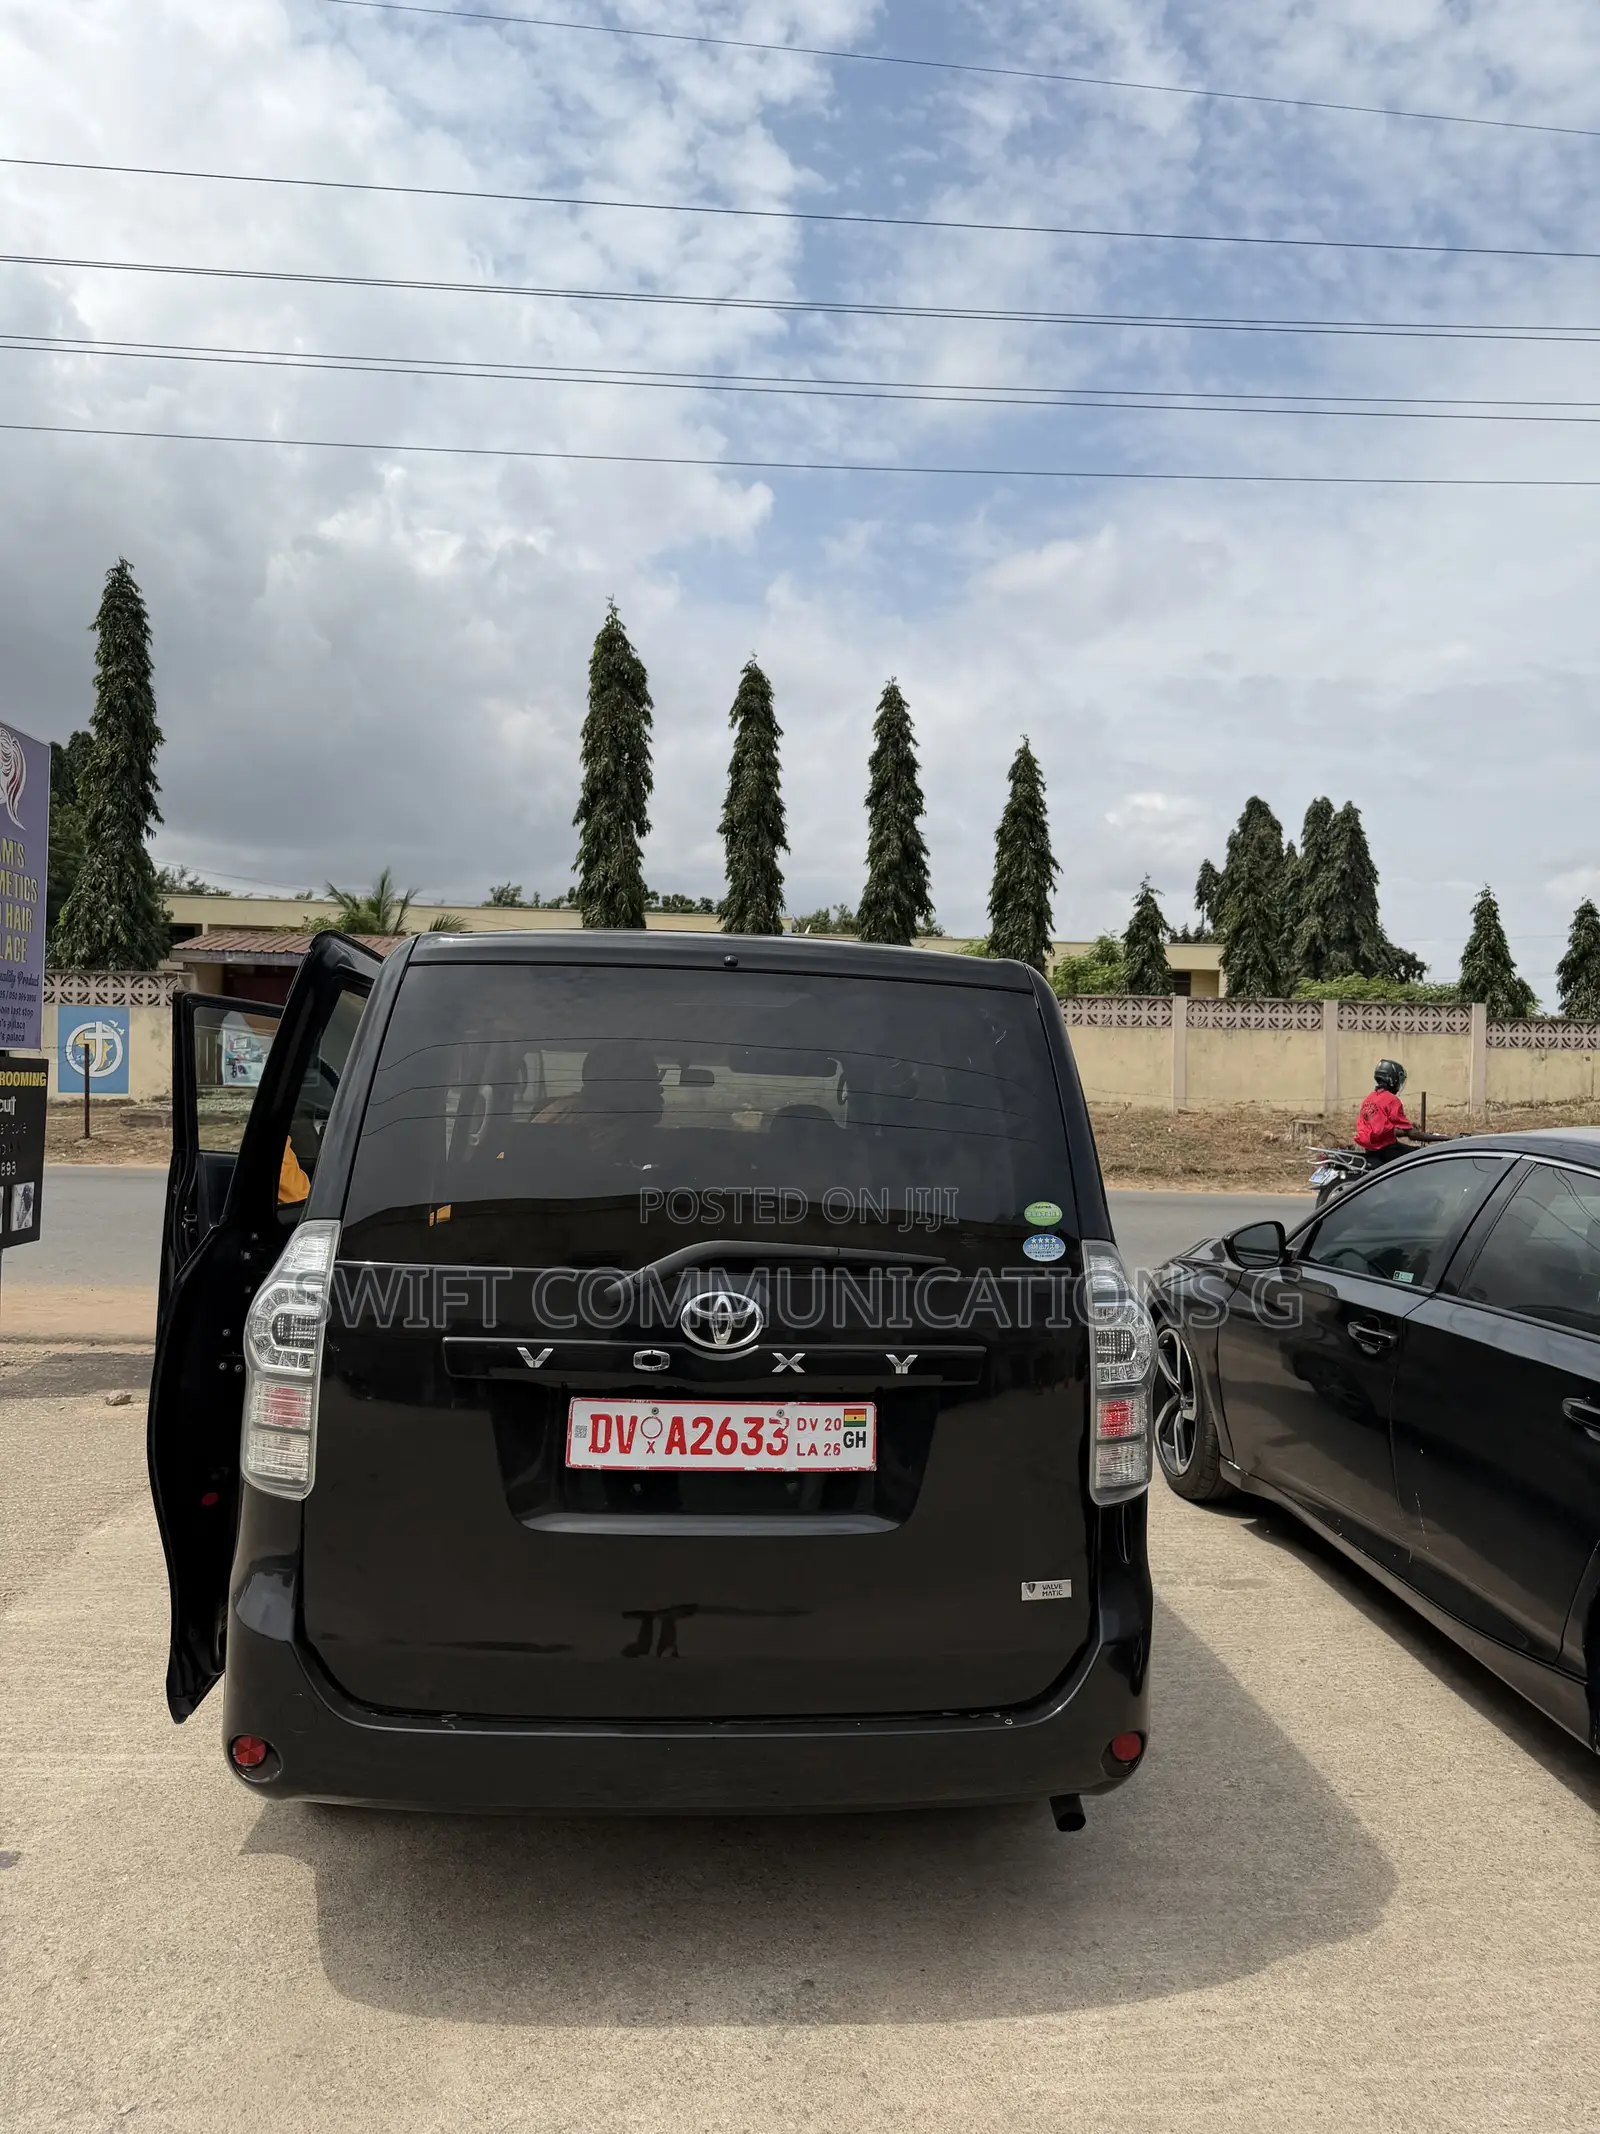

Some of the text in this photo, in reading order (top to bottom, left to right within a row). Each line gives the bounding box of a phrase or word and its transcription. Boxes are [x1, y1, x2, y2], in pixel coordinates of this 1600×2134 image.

[0, 837, 26, 869] M'S
[5, 902, 33, 934] HAIR
[0, 1071, 47, 1087] ROOMING
[516, 1346, 919, 1375] VOXY
[796, 1417, 842, 1432] DV 20
[588, 1413, 790, 1456] DV A2633
[842, 1430, 867, 1449] GH
[796, 1442, 841, 1457] LA 26
[1041, 1583, 1063, 1591] VALVE
